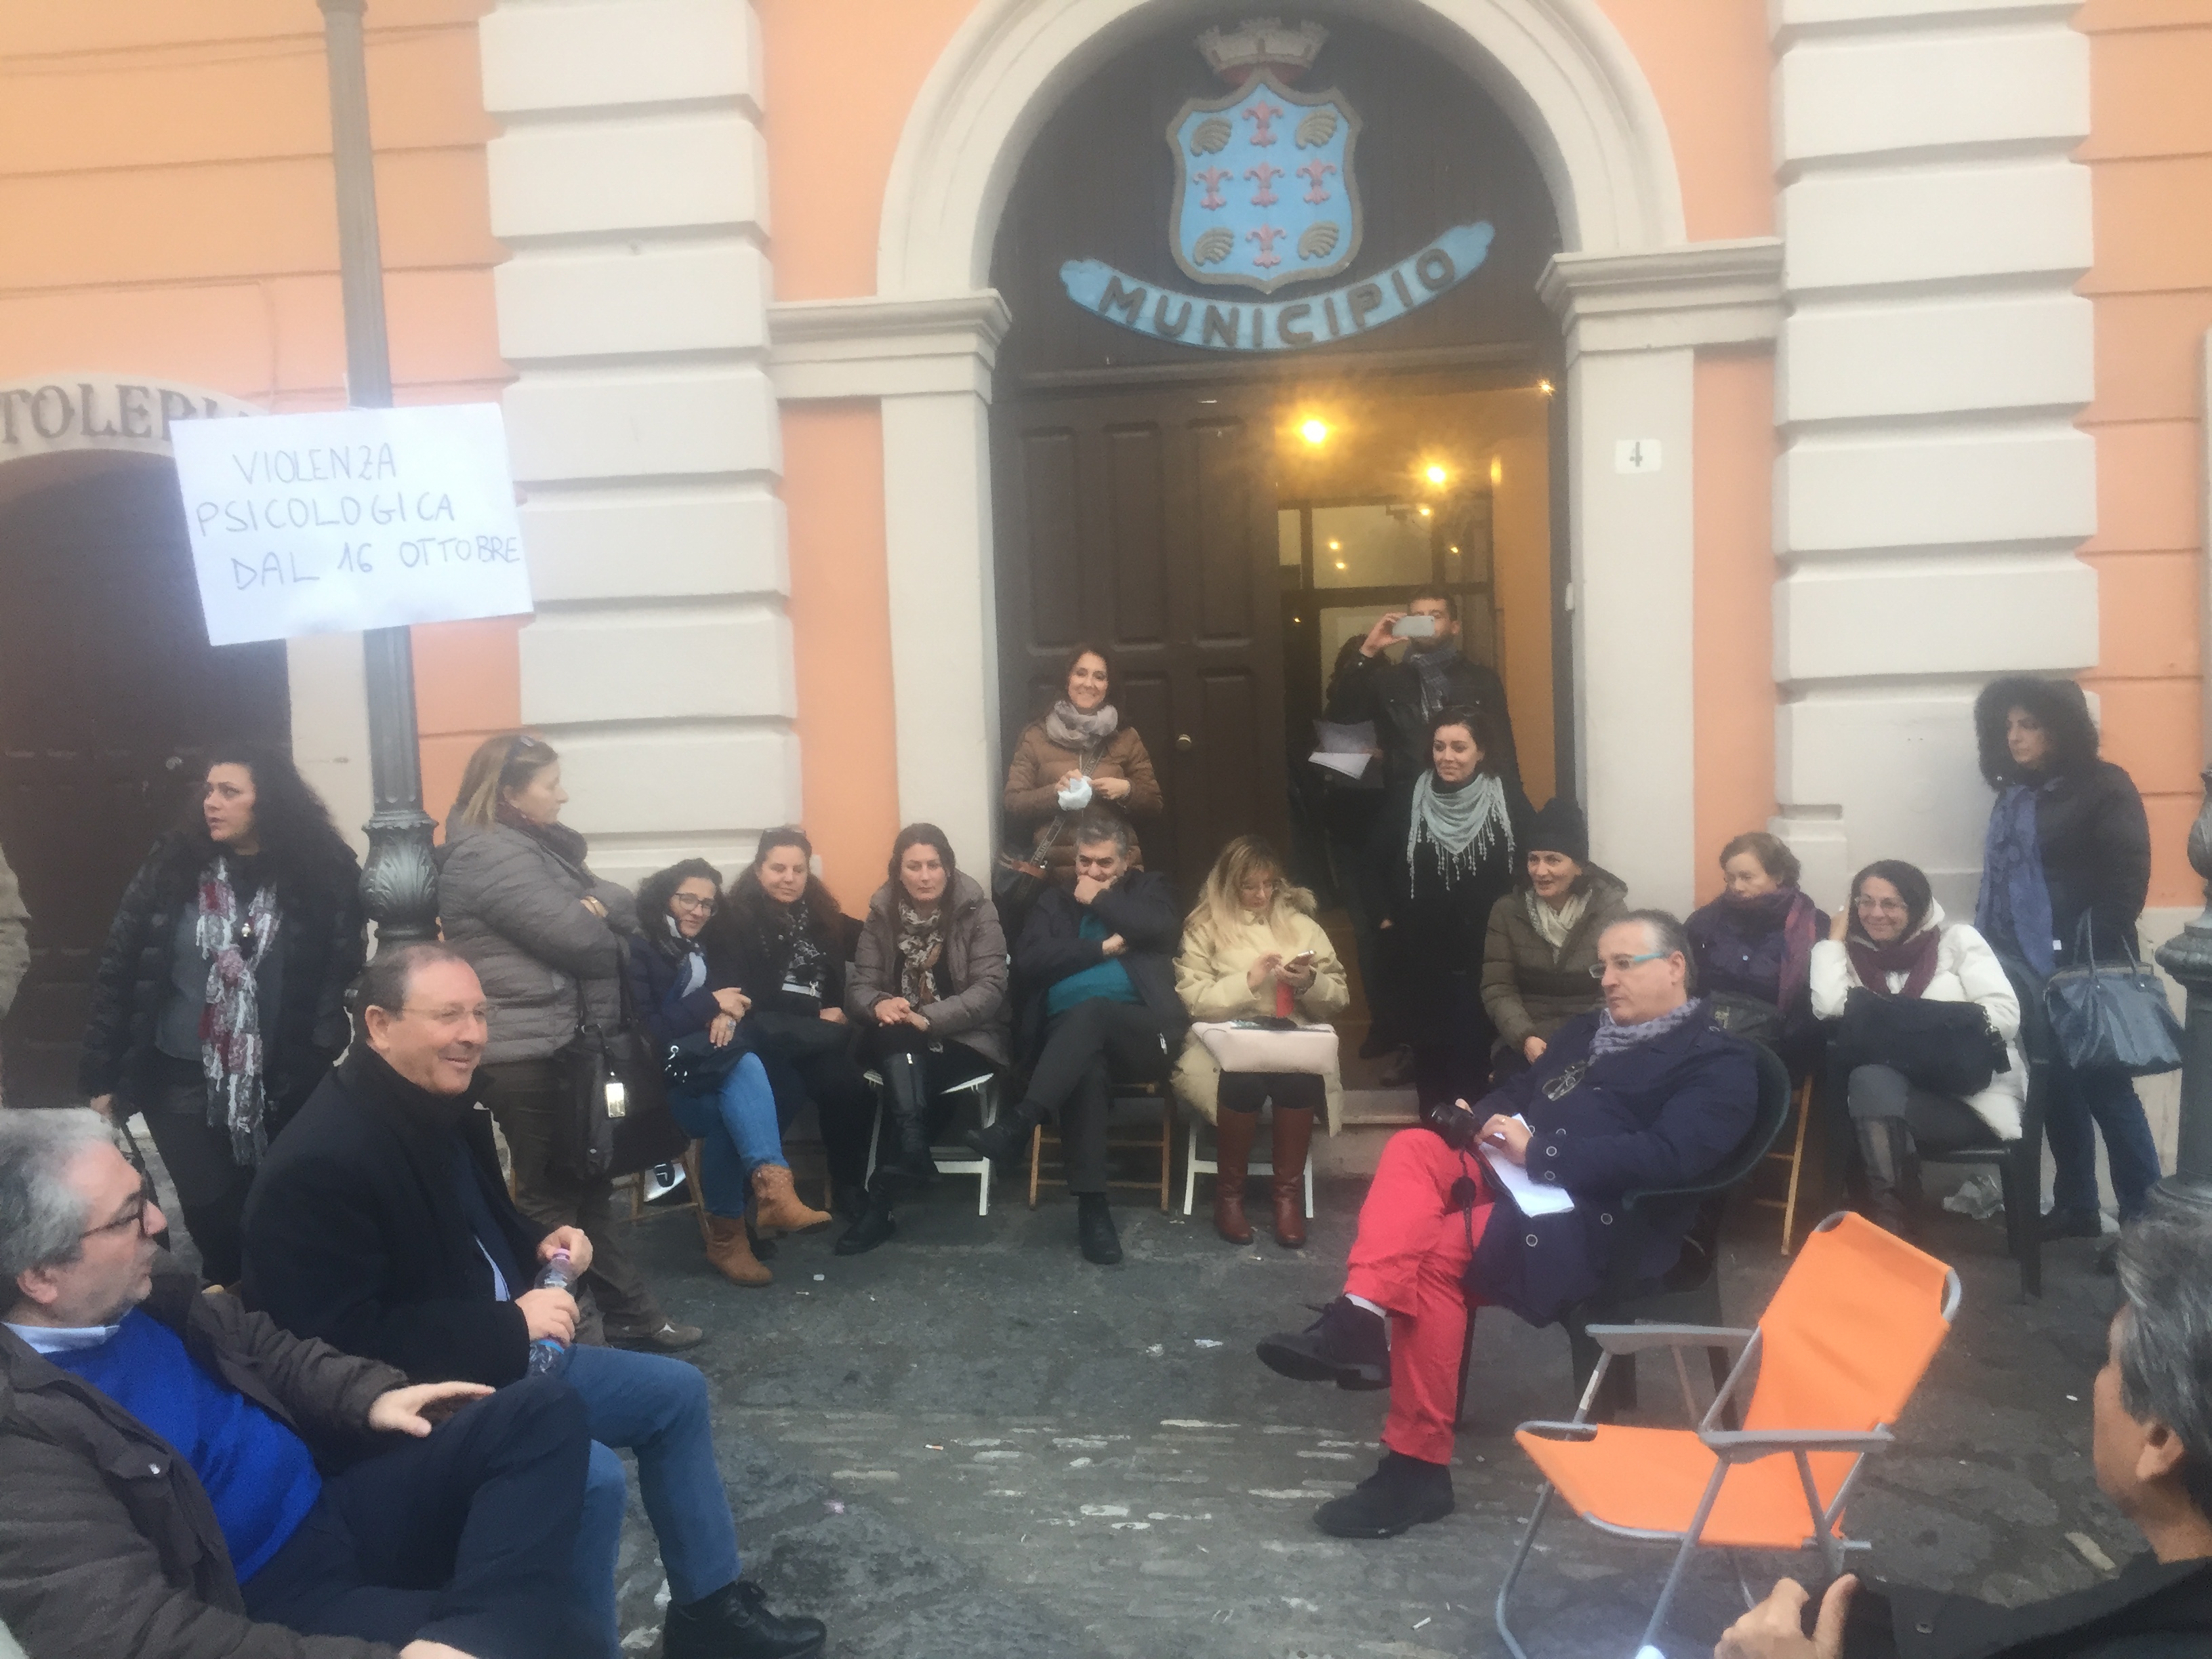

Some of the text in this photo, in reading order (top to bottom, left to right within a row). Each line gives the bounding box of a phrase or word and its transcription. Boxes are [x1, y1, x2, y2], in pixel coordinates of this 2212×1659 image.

[1100, 248, 1456, 347] MUNICIPIO
[232, 443, 396, 485] VIOLENZA
[1629, 441, 1643, 468] 4
[196, 491, 455, 537] PSICOLOGICA
[231, 536, 520, 590] DAL 16 OTTOBRE
